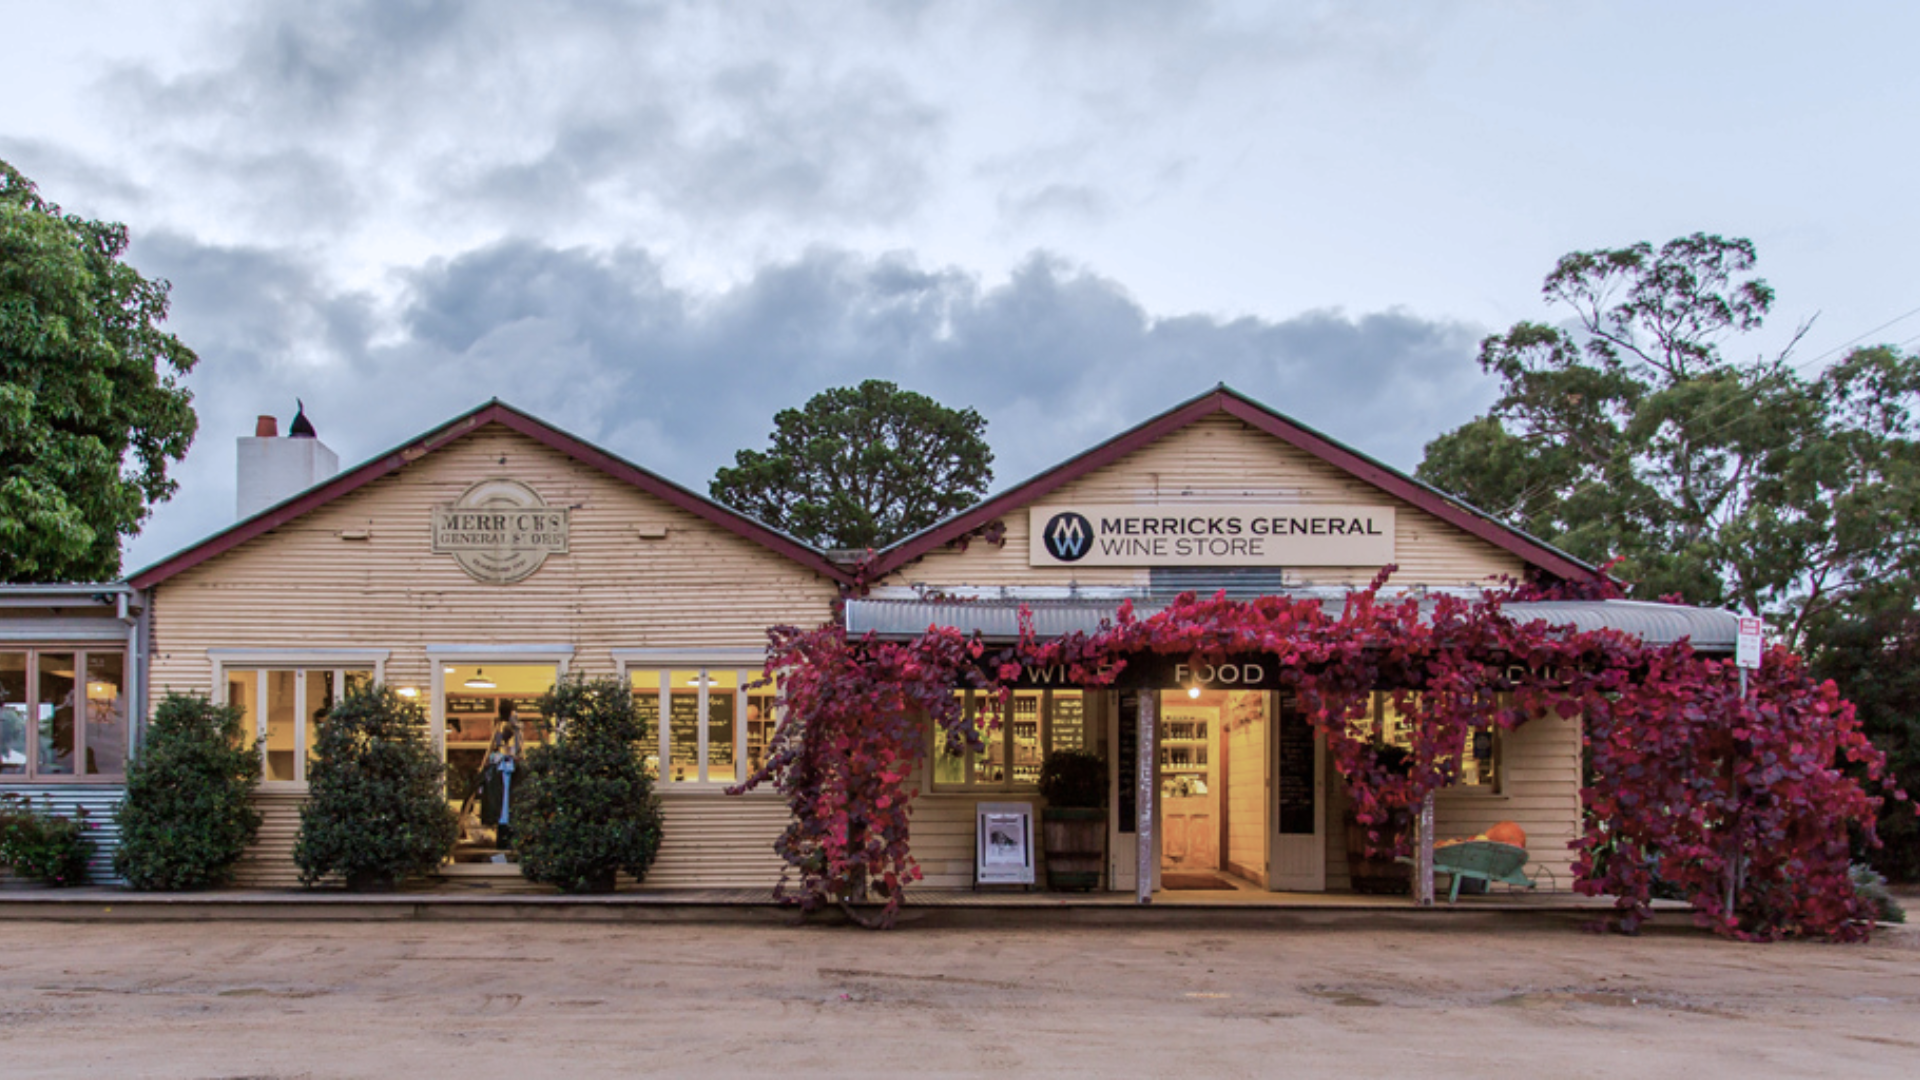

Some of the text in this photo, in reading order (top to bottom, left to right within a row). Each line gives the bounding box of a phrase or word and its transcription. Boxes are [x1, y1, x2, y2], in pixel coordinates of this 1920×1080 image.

[441, 514, 560, 531] MERRICKS
[1101, 517, 1383, 535] MERRICKS GENERAL
[1100, 538, 1264, 555] WINE STORE
[1175, 664, 1264, 683] FOOD
